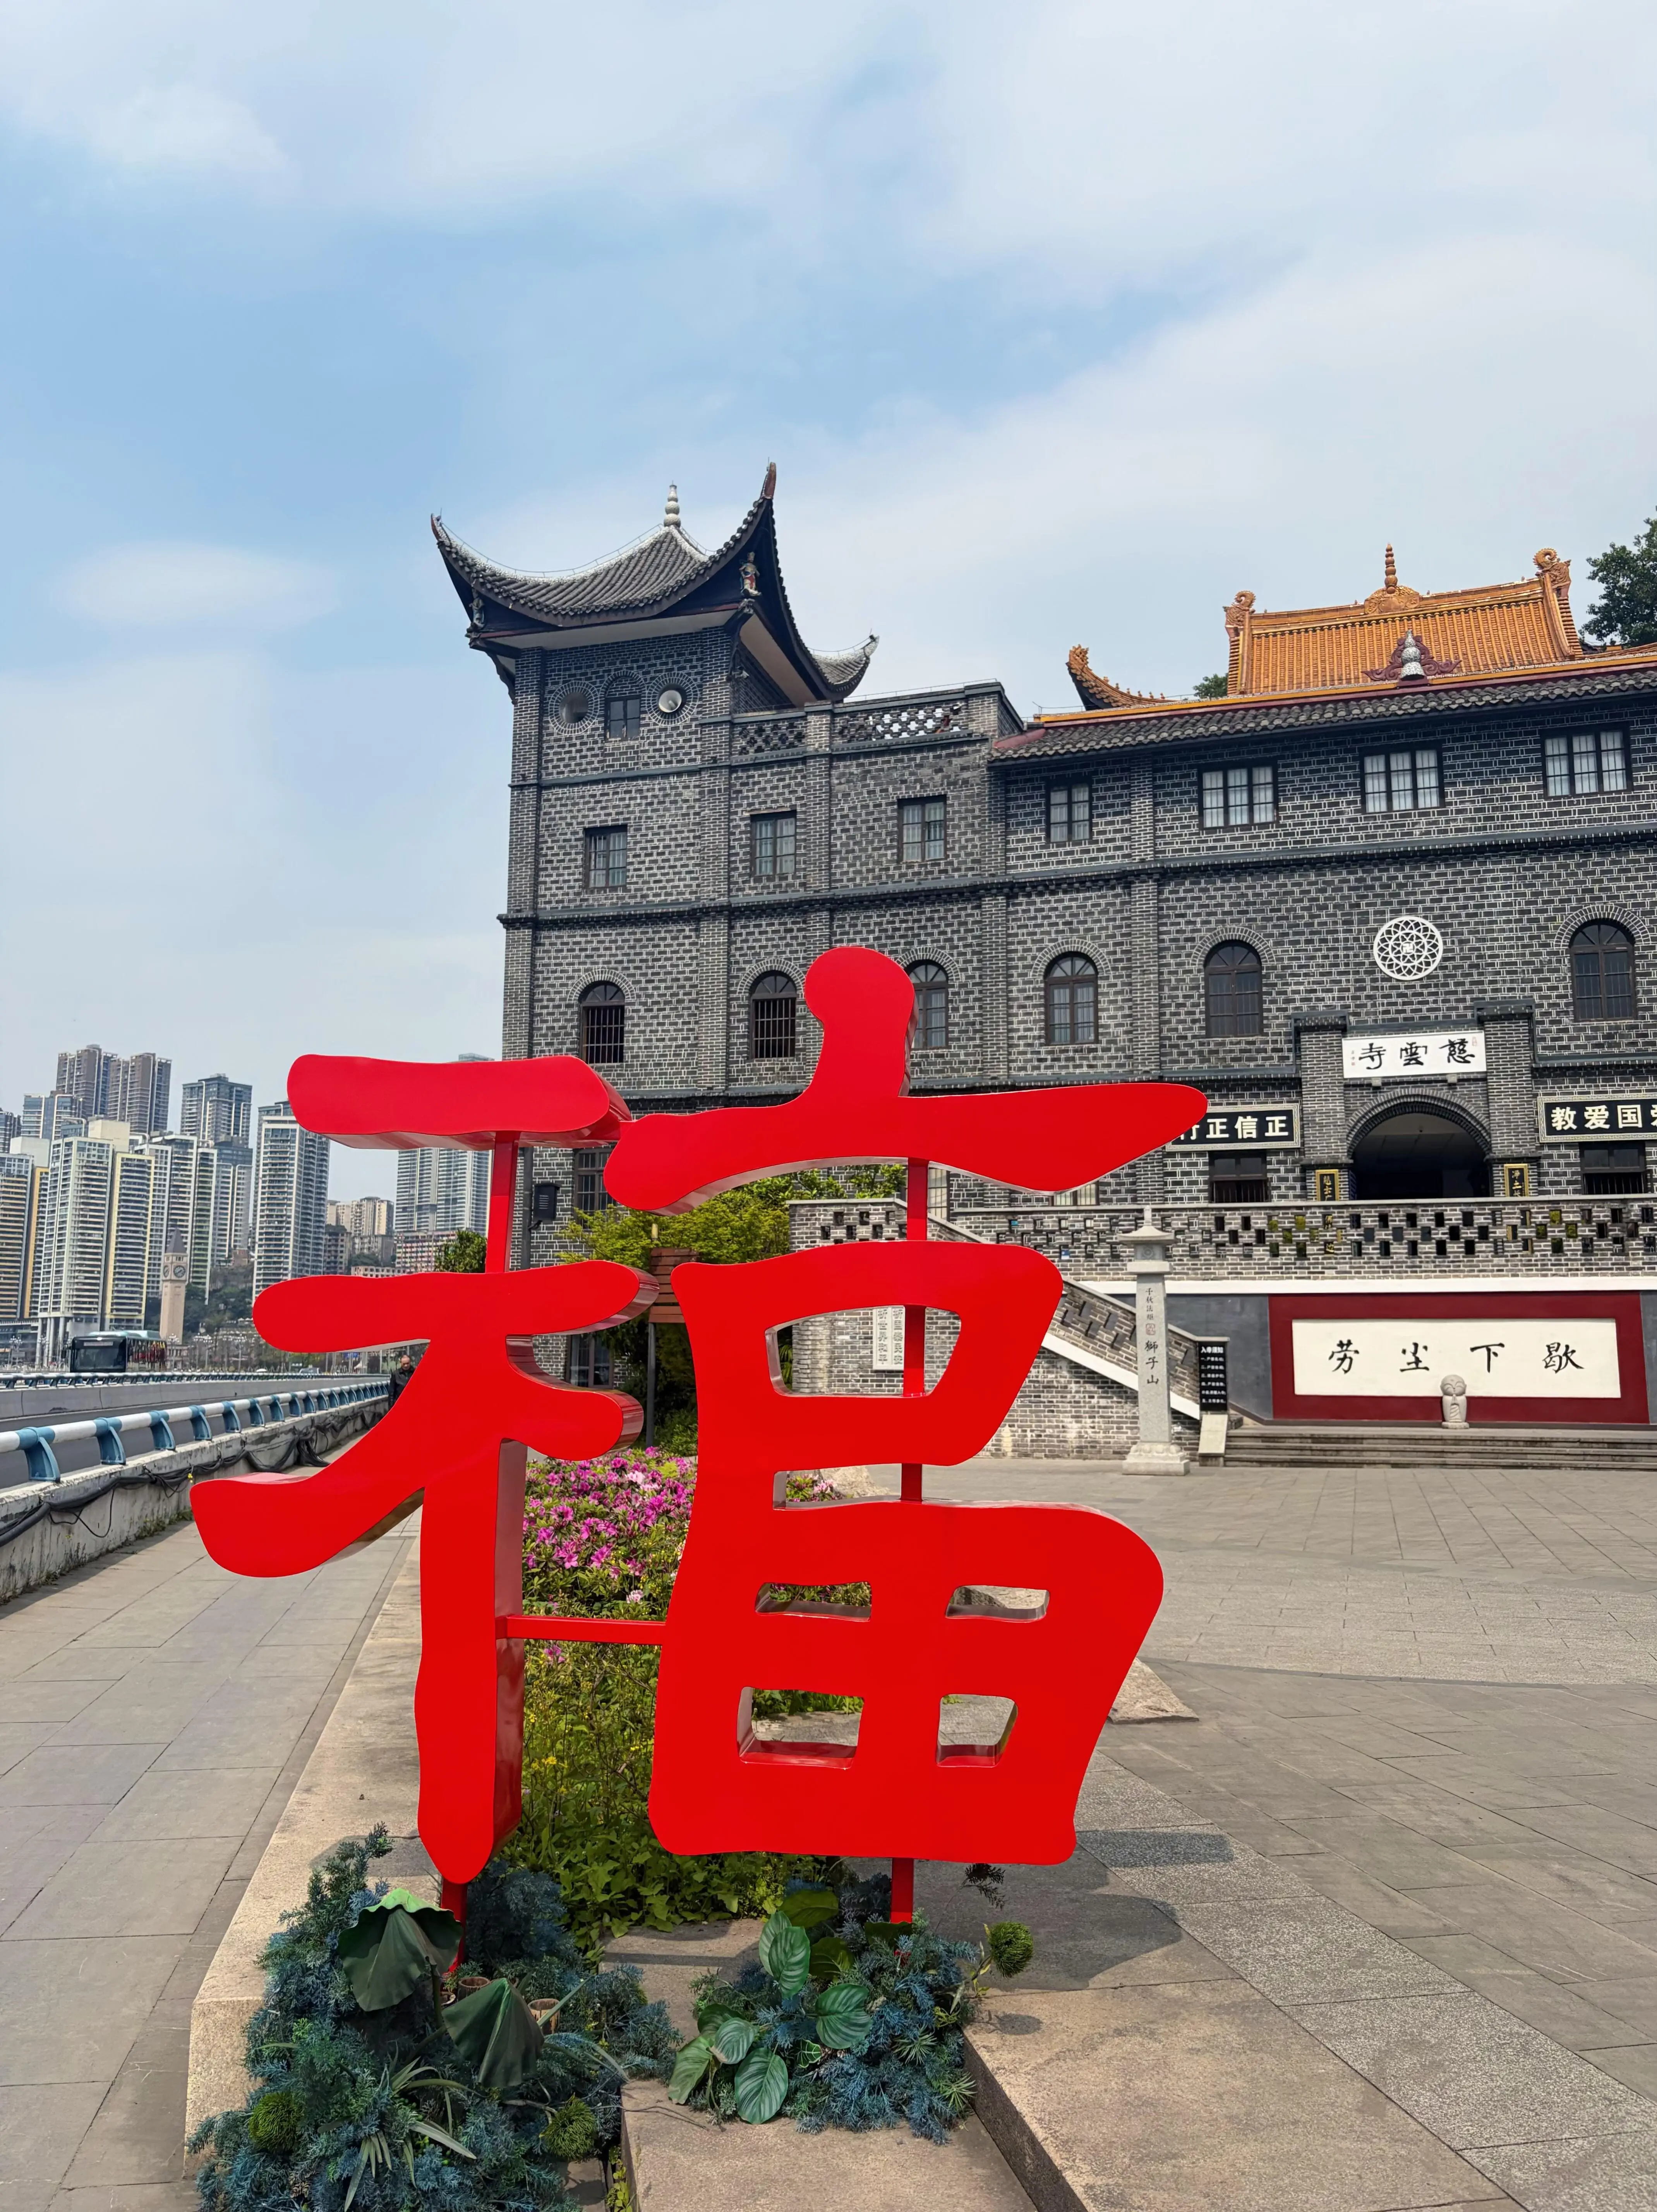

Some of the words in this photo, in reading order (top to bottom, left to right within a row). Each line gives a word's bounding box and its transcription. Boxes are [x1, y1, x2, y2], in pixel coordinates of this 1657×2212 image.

[1551, 1105, 1657, 1130] 国爱教
[1145, 1340, 1159, 1384] 獅子山
[190, 948, 1208, 1884] 福
